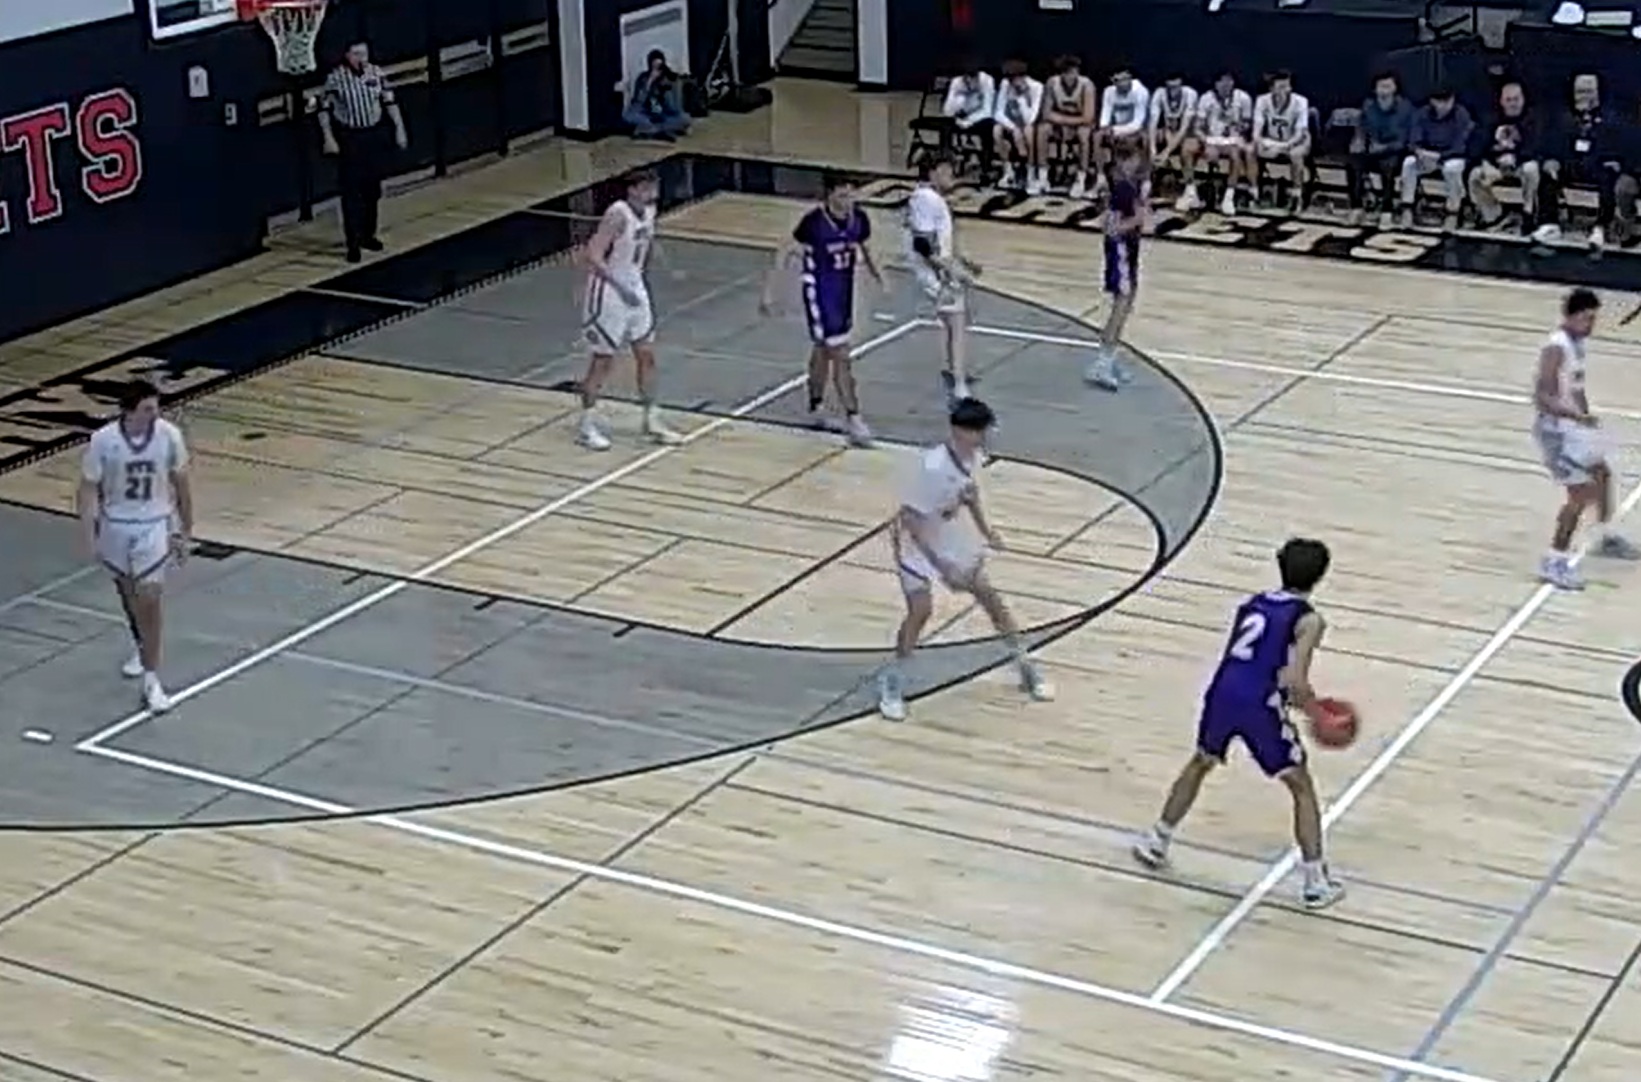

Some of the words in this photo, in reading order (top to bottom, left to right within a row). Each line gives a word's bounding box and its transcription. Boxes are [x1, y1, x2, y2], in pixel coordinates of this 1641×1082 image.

[0, 87, 142, 233] TS
[125, 476, 153, 501] 21
[1230, 613, 1266, 661] 2
